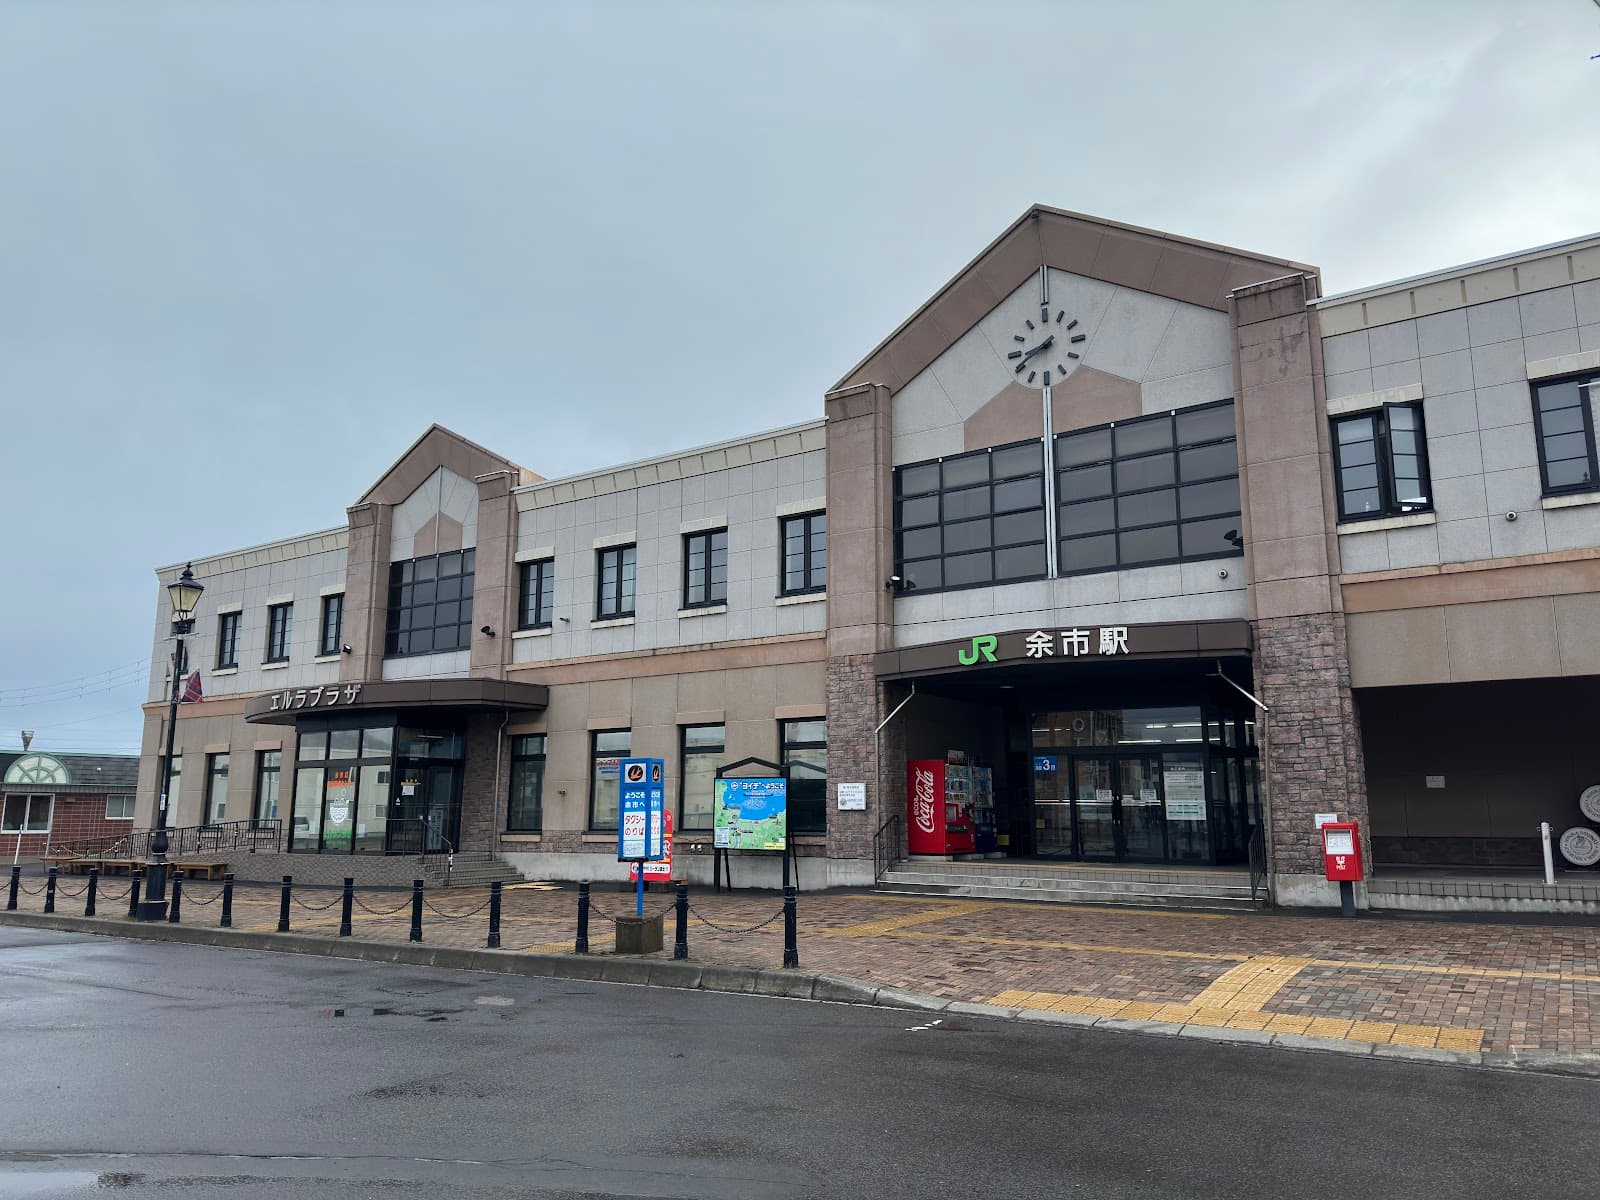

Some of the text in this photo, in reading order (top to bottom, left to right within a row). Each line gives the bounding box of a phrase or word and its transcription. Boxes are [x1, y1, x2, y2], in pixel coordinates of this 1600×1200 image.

[959, 626, 1130, 666] JR 余市駅
[625, 791, 646, 799] ようこそ
[625, 815, 645, 824] タクシー
[625, 827, 645, 836] のりば
